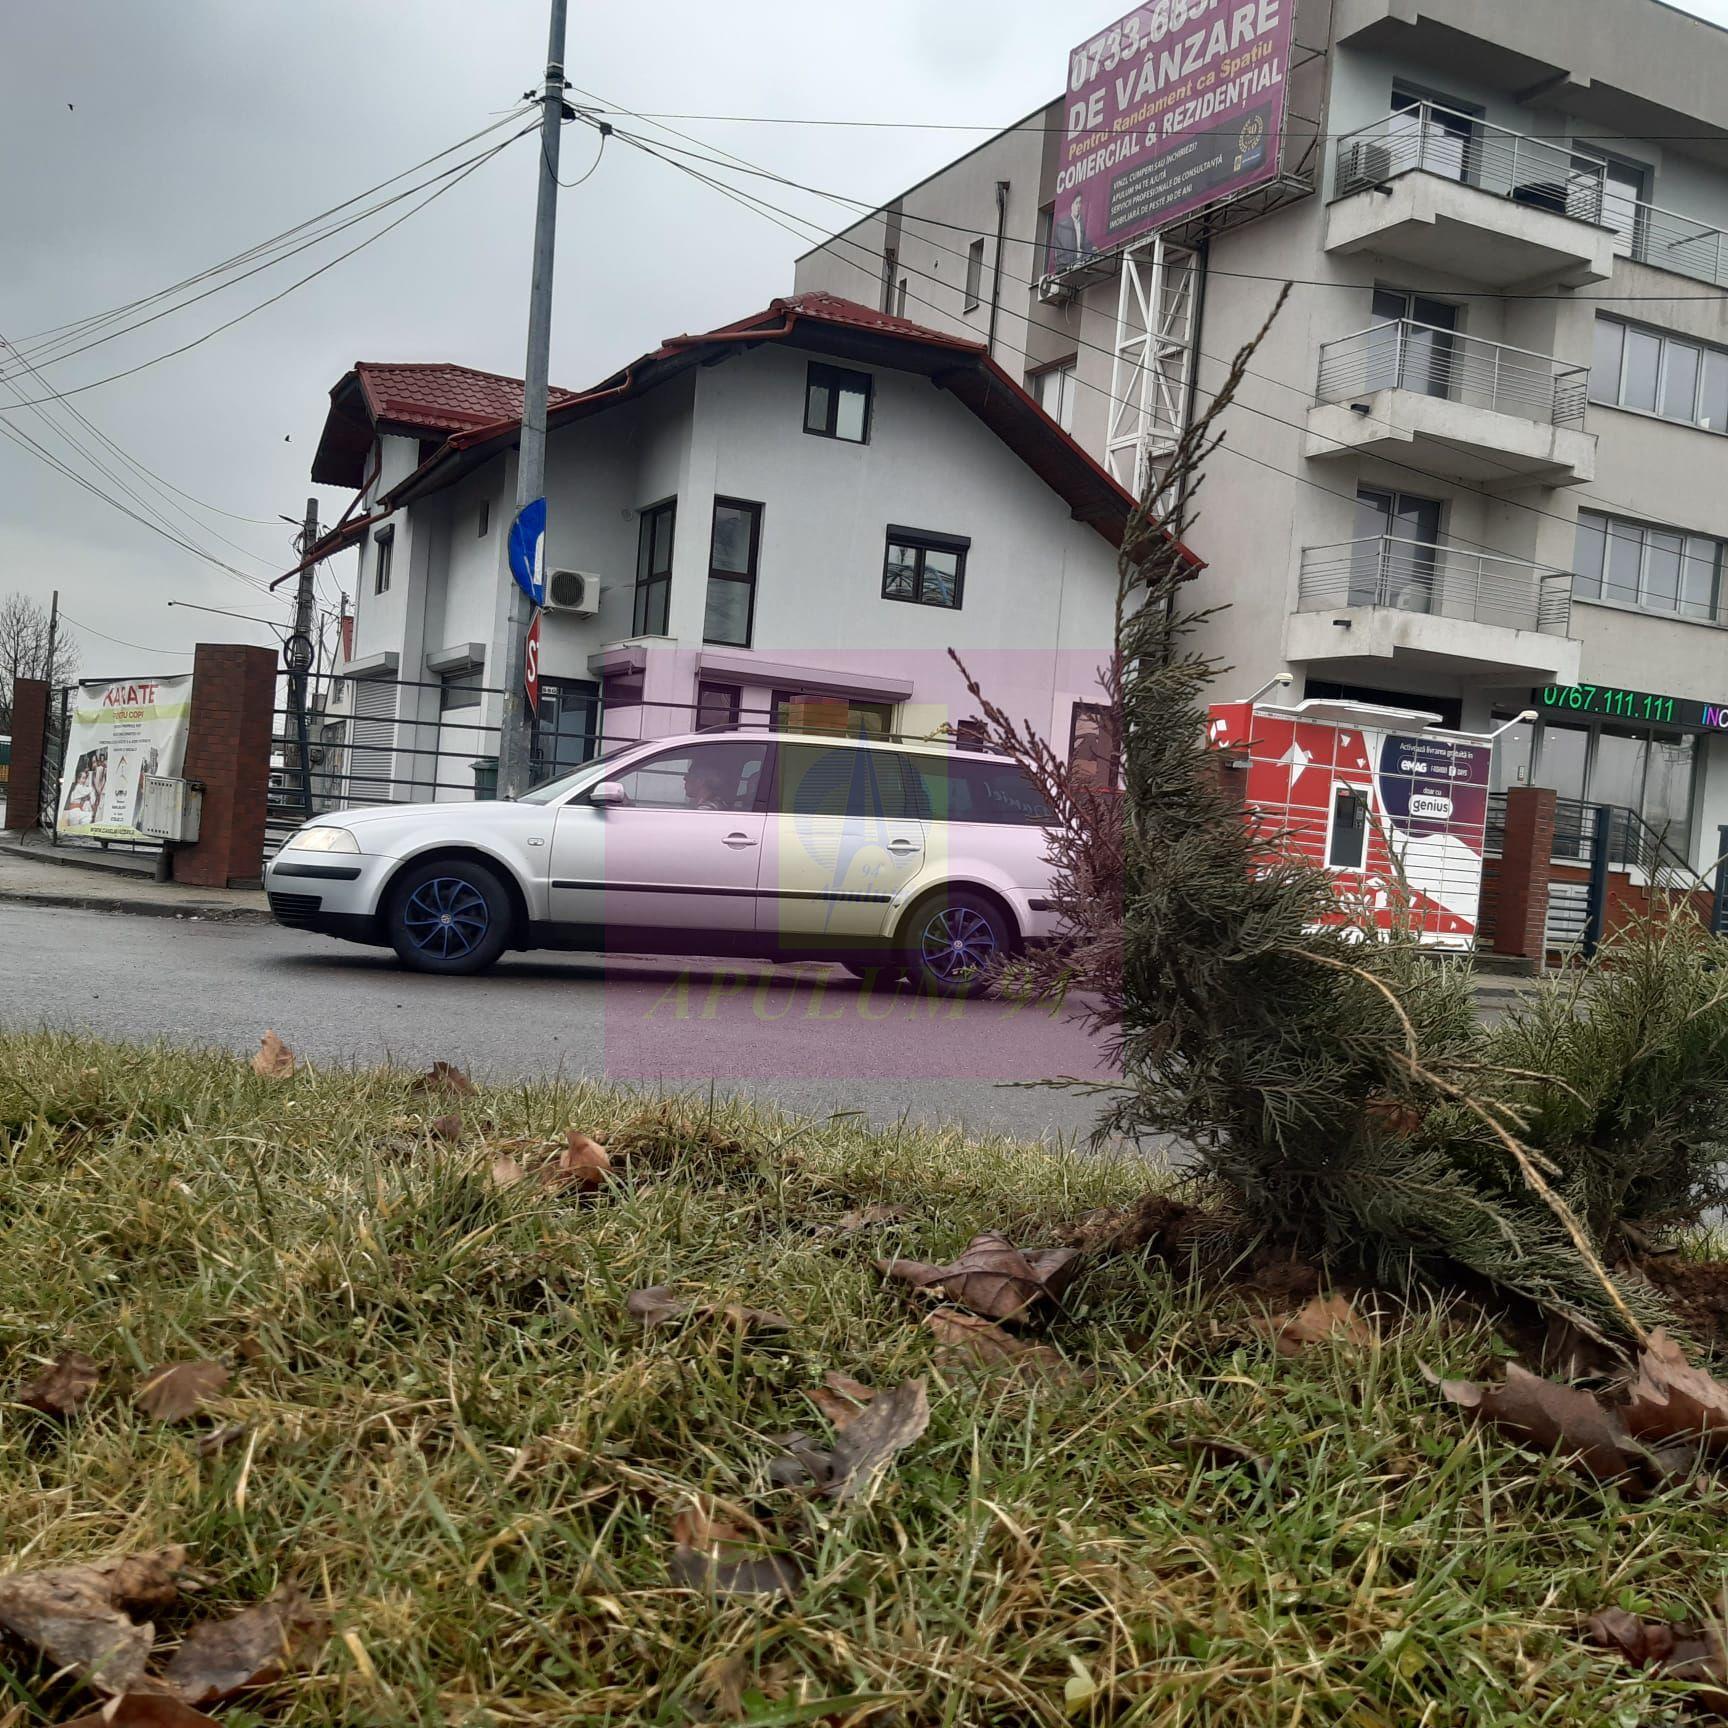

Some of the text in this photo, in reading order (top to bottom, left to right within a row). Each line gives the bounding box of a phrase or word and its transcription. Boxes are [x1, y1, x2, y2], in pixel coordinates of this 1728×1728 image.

[1067, 0, 1280, 141] DE VÂNZARE
[1056, 133, 1140, 195] COMERCIAL
[1145, 121, 1157, 147] &
[1162, 58, 1282, 139] REZIDENȚIAL
[1068, 126, 1108, 161] Pentru
[1112, 80, 1193, 137] Randament
[1196, 71, 1215, 90] ca
[1132, 180, 1173, 206] PROFESIONALE
[1173, 175, 1181, 187] DE
[1140, 203, 1149, 214] DE
[1174, 189, 1182, 201] DE
[1401, 760, 1427, 773] eMAG
[1413, 798, 1449, 813] genius
